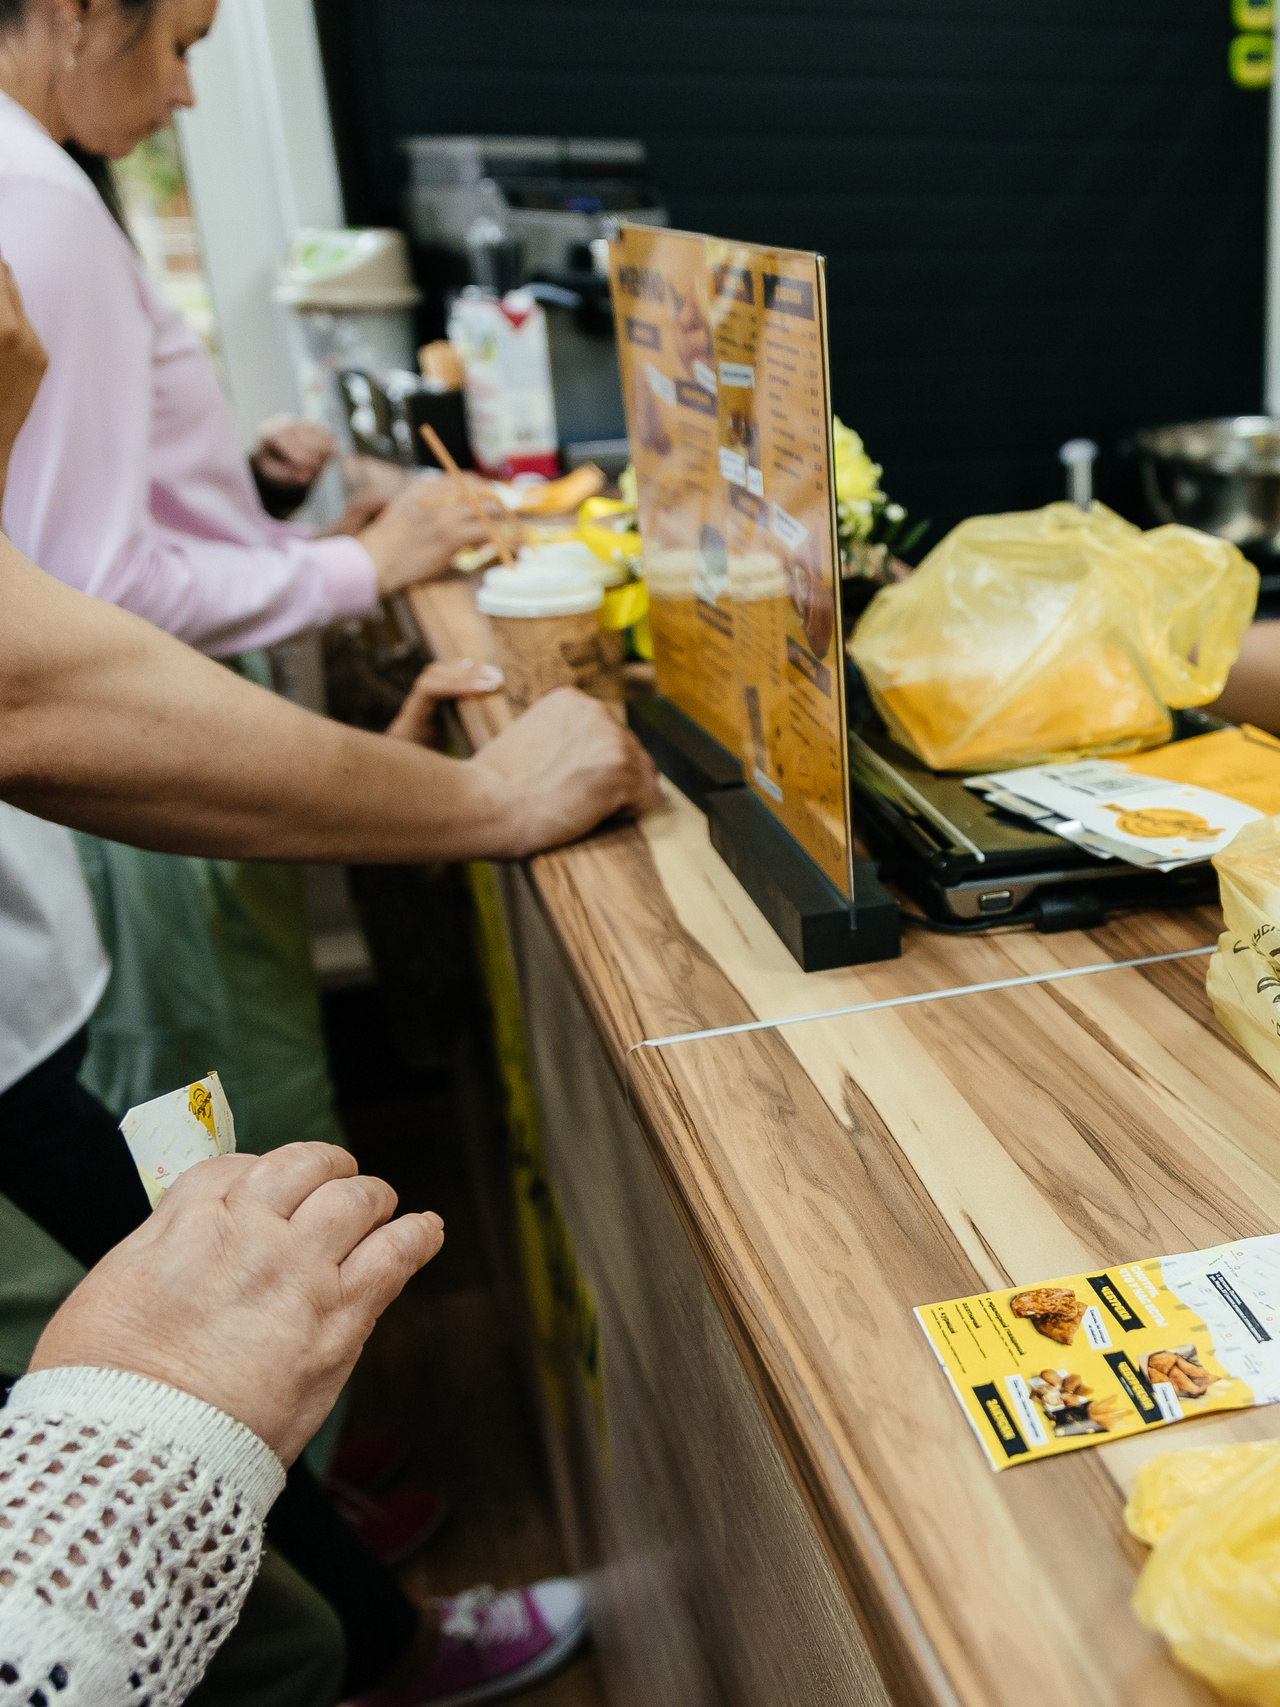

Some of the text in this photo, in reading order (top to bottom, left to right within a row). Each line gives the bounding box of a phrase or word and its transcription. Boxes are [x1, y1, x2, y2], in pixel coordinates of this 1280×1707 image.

[1100, 1285, 1132, 1321] ЧЕБУРЕКИ
[1118, 1267, 1135, 1283] ЧТО
[1132, 1286, 1151, 1305] НАС
